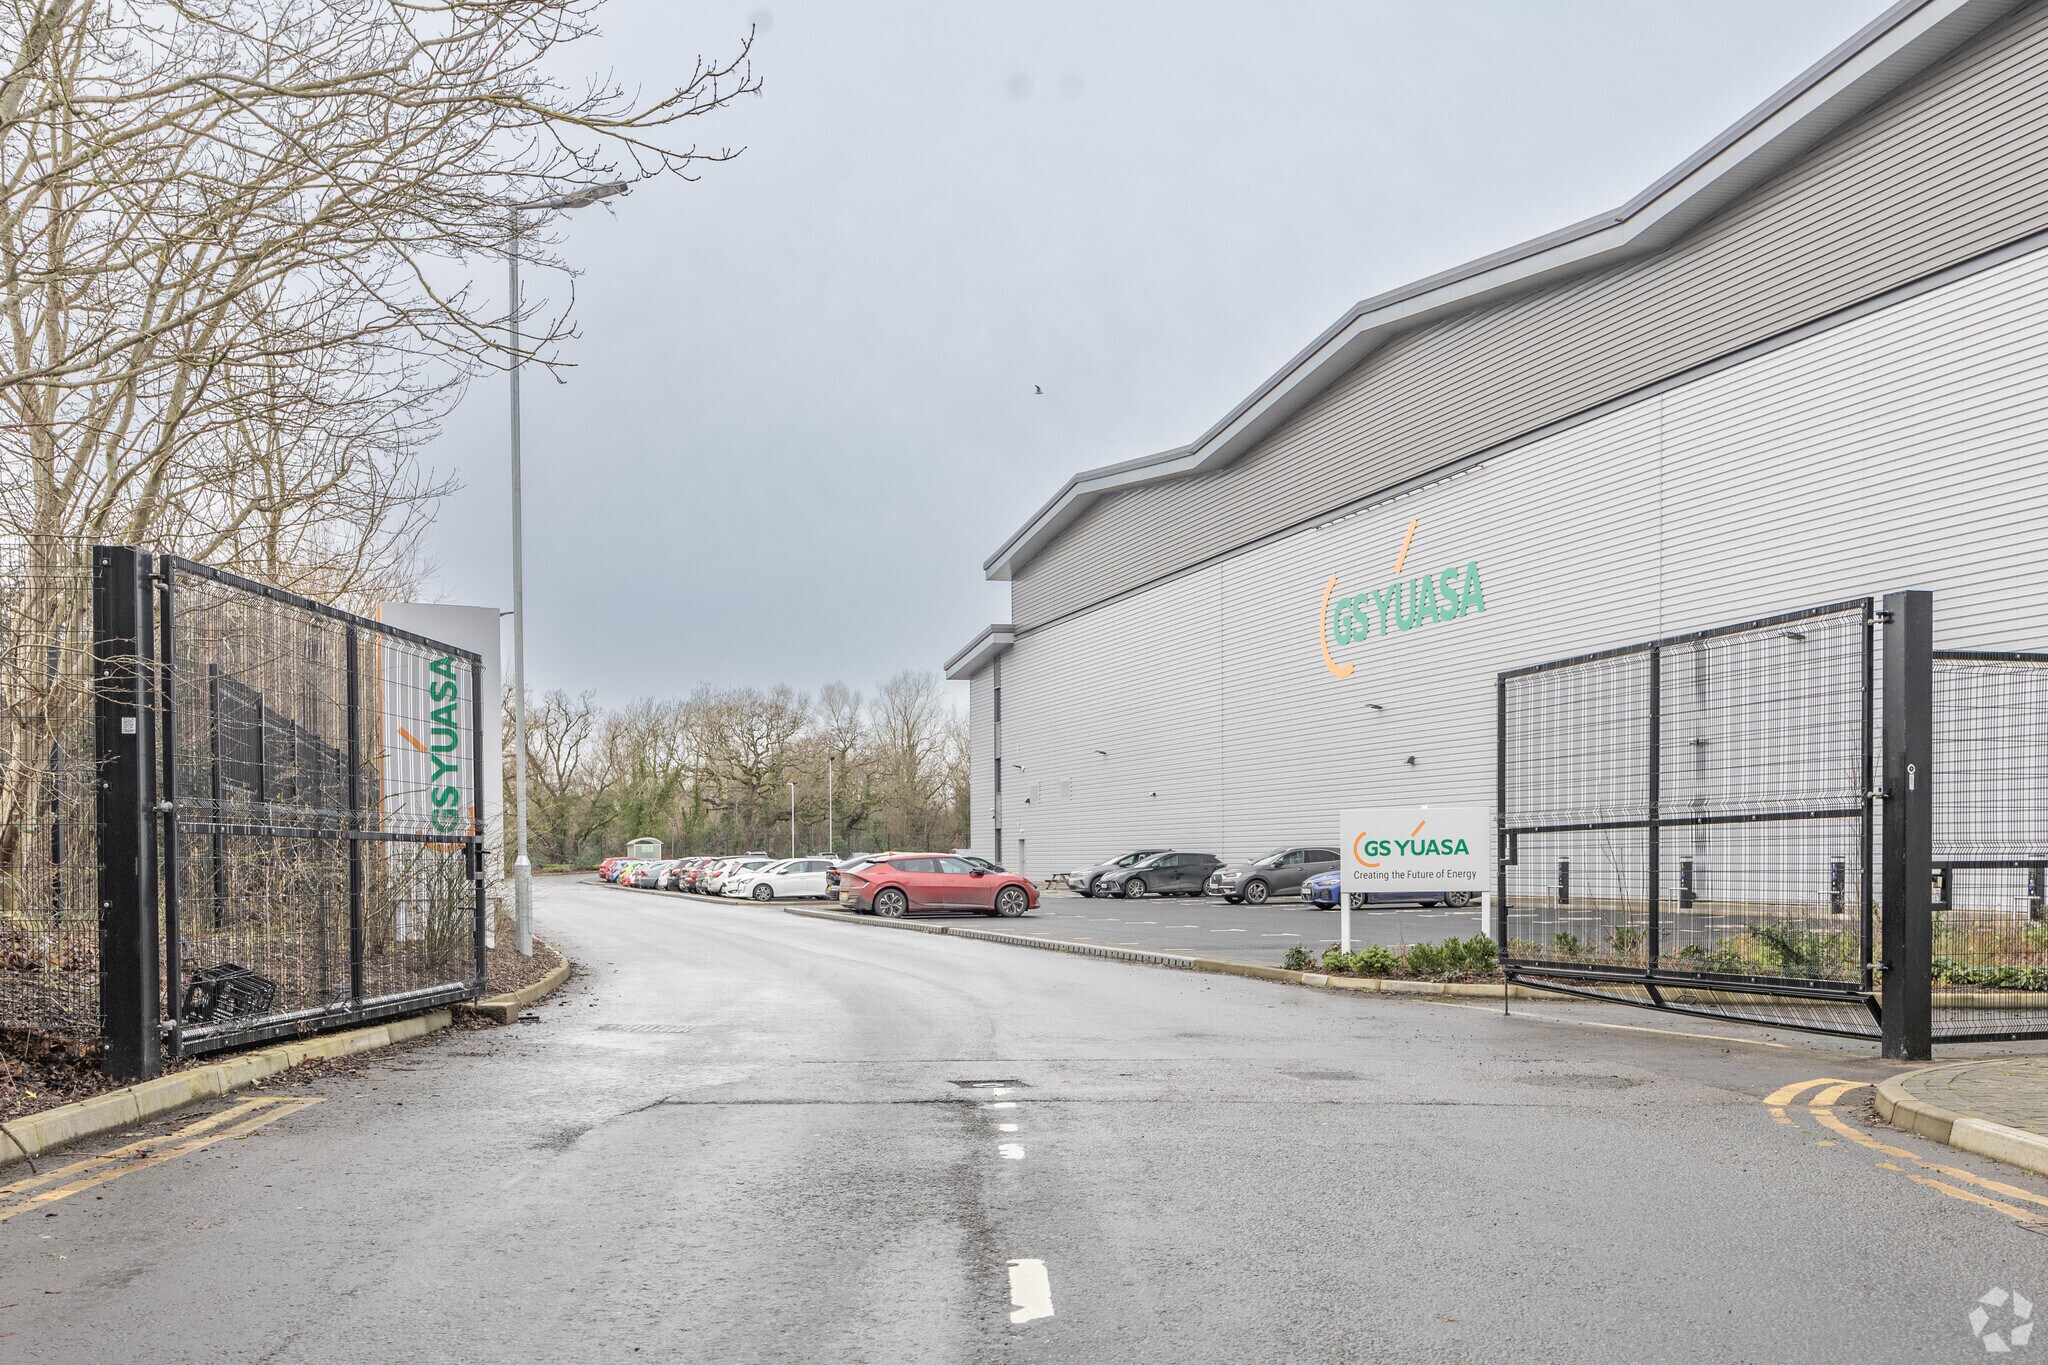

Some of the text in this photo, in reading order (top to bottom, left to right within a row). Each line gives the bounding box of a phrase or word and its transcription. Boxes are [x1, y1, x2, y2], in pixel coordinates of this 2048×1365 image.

[1333, 561, 1486, 646] GS YUASA
[429, 655, 460, 833] GS YUASA
[1364, 839, 1470, 857] GS YUASA
[1353, 869, 1477, 881] Creating the Future of Energy
